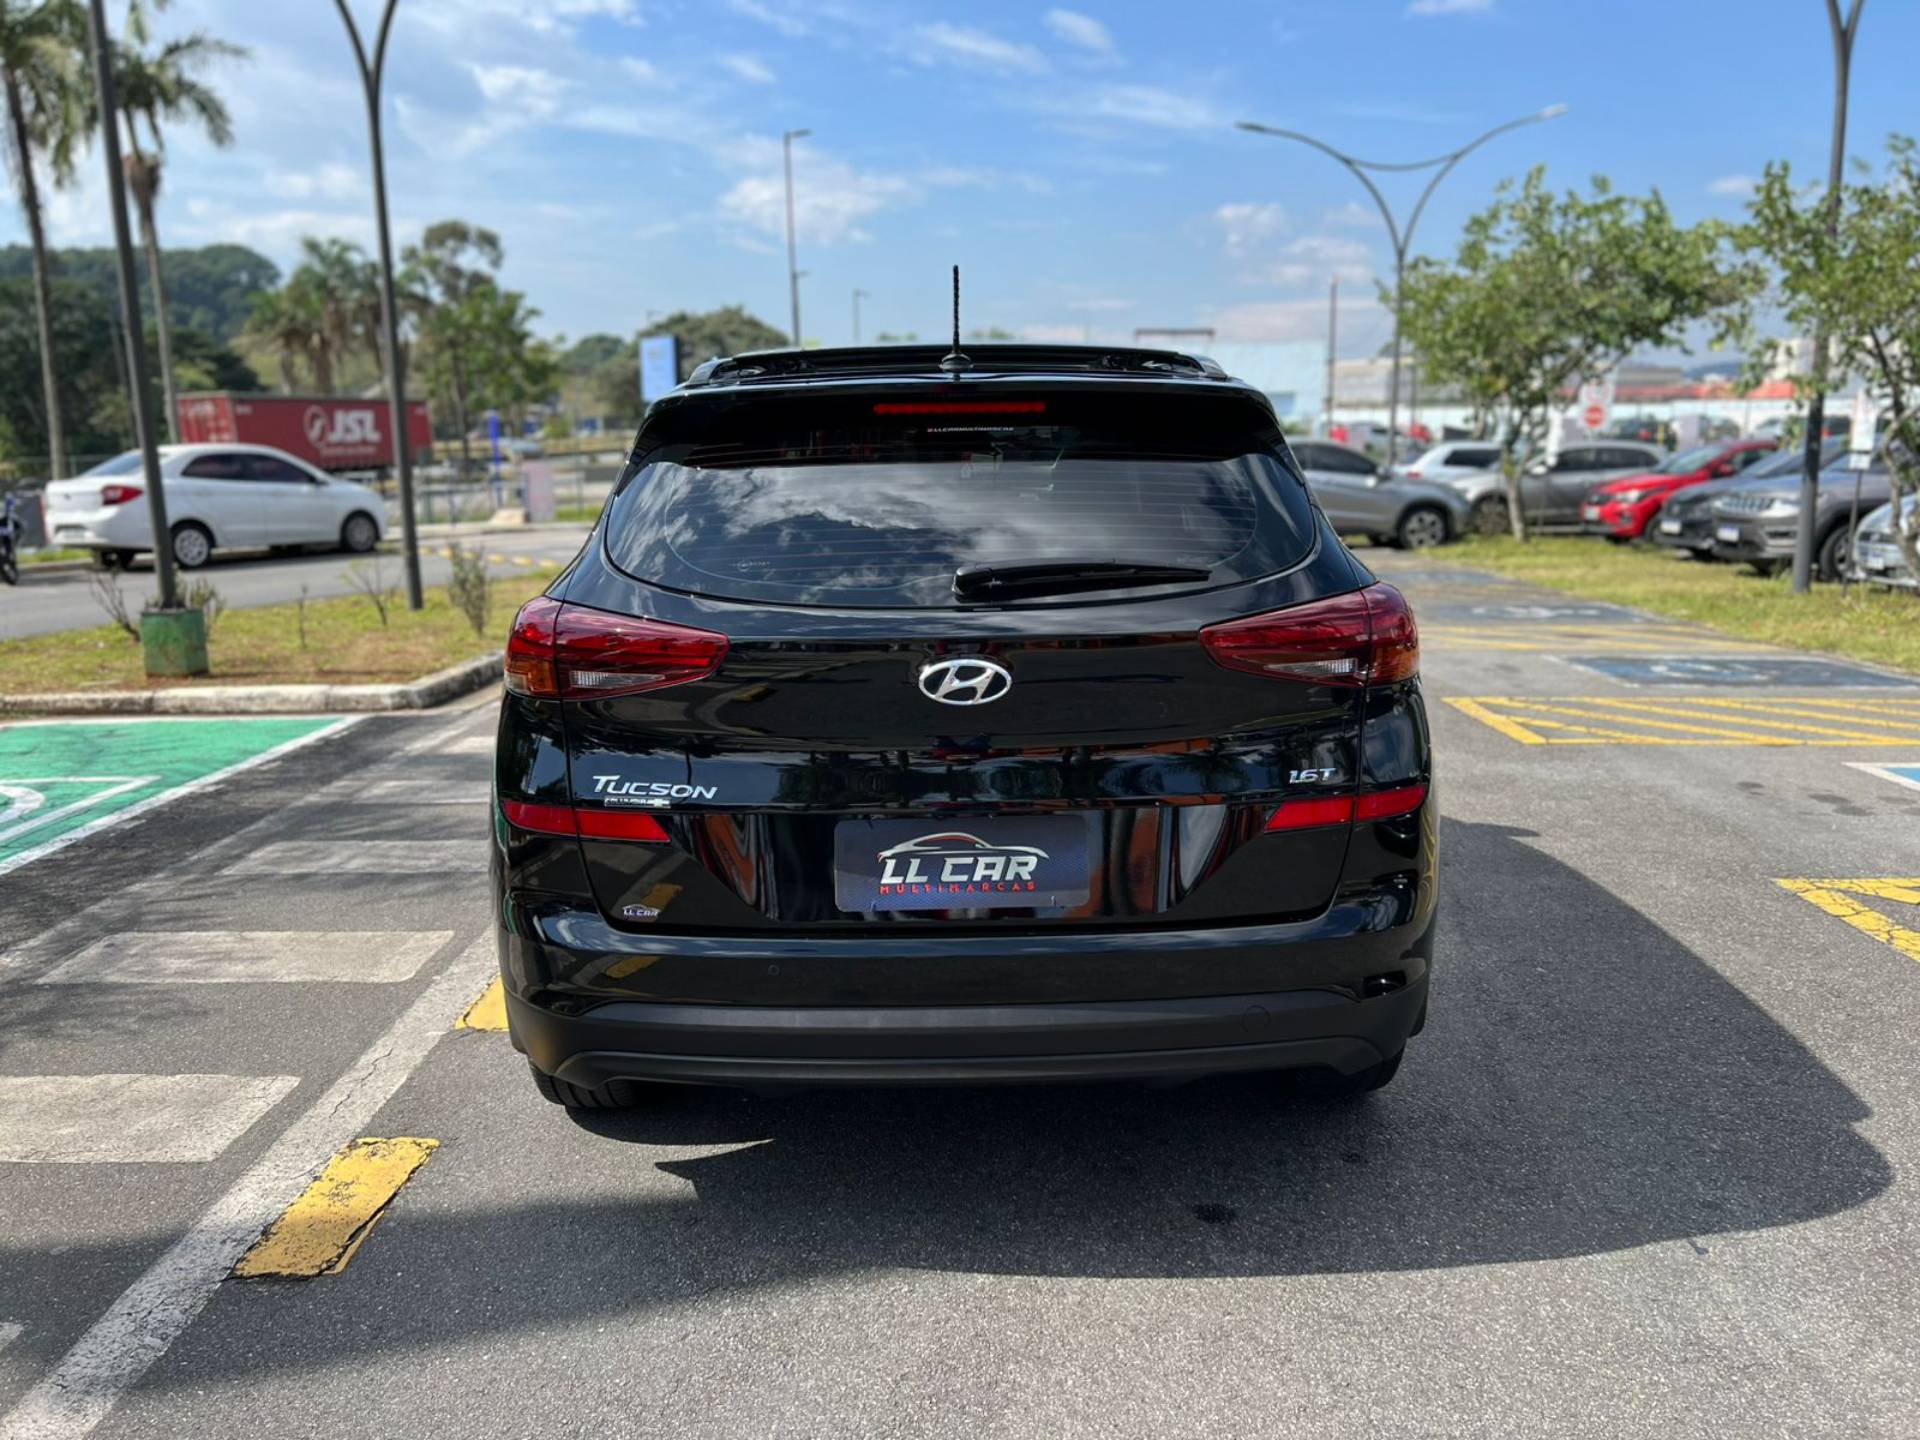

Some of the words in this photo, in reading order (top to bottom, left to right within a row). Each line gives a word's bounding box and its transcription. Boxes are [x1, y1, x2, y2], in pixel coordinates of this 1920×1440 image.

[327, 409, 382, 443] JSL
[880, 858, 929, 884] LL
[940, 856, 1039, 882] CAR
[879, 881, 1036, 895] MULTIMARCAS
